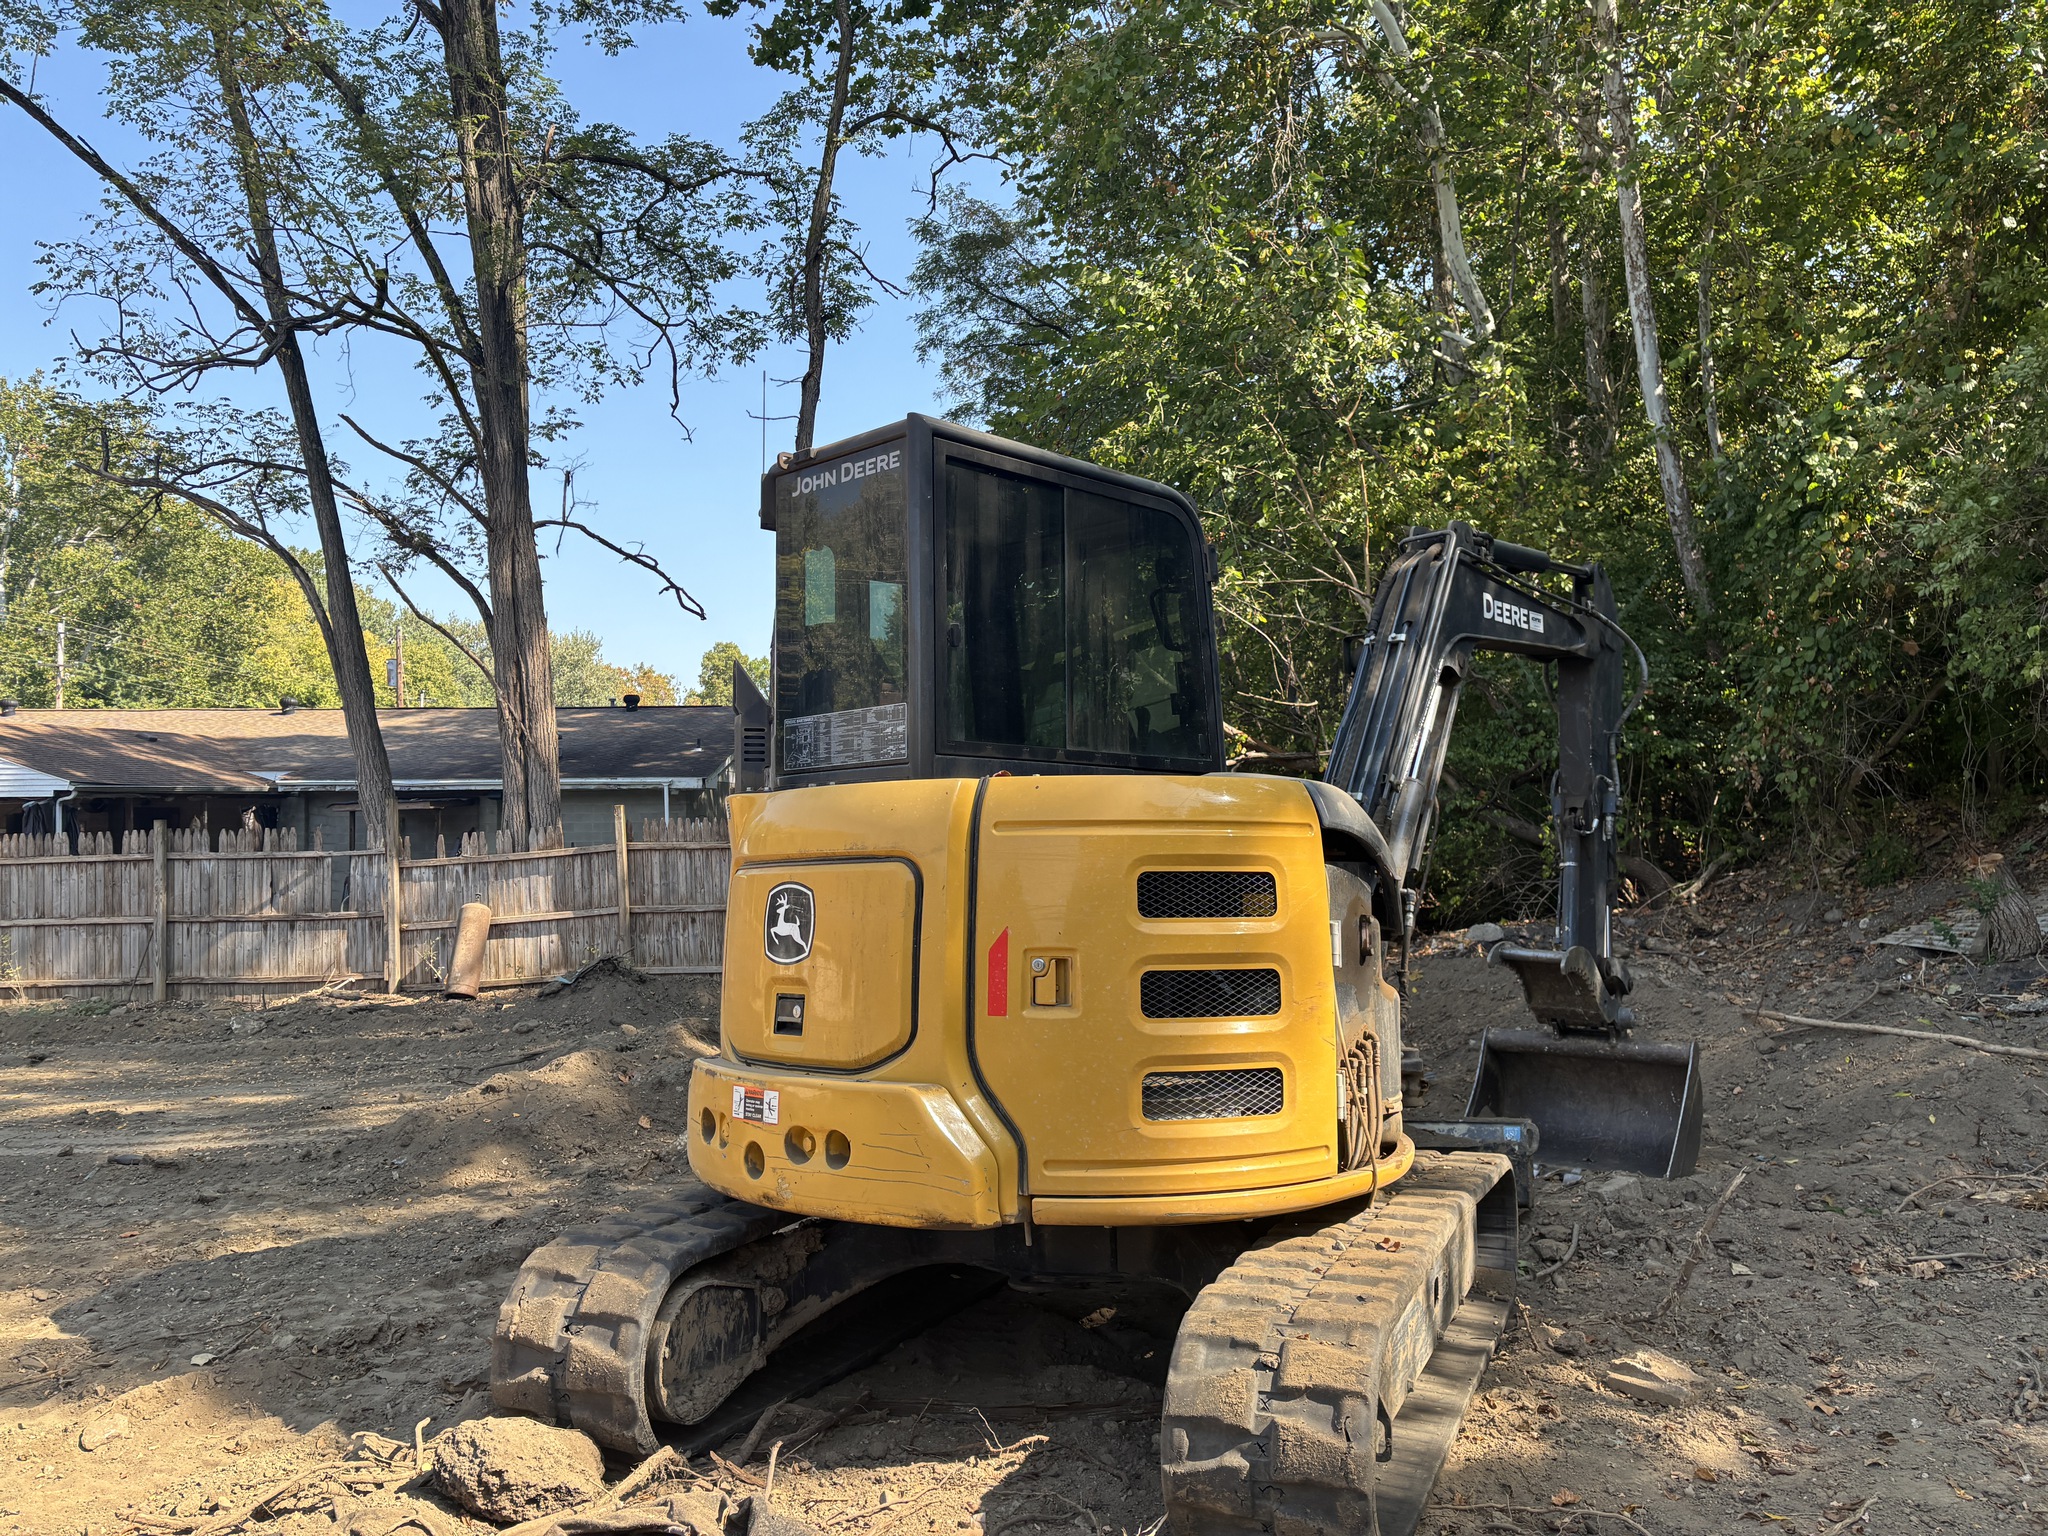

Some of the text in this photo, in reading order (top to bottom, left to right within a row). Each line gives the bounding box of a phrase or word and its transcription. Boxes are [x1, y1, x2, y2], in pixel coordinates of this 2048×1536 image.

[792, 450, 900, 497] JOHN DEERE
[1482, 592, 1529, 630] DEERE
